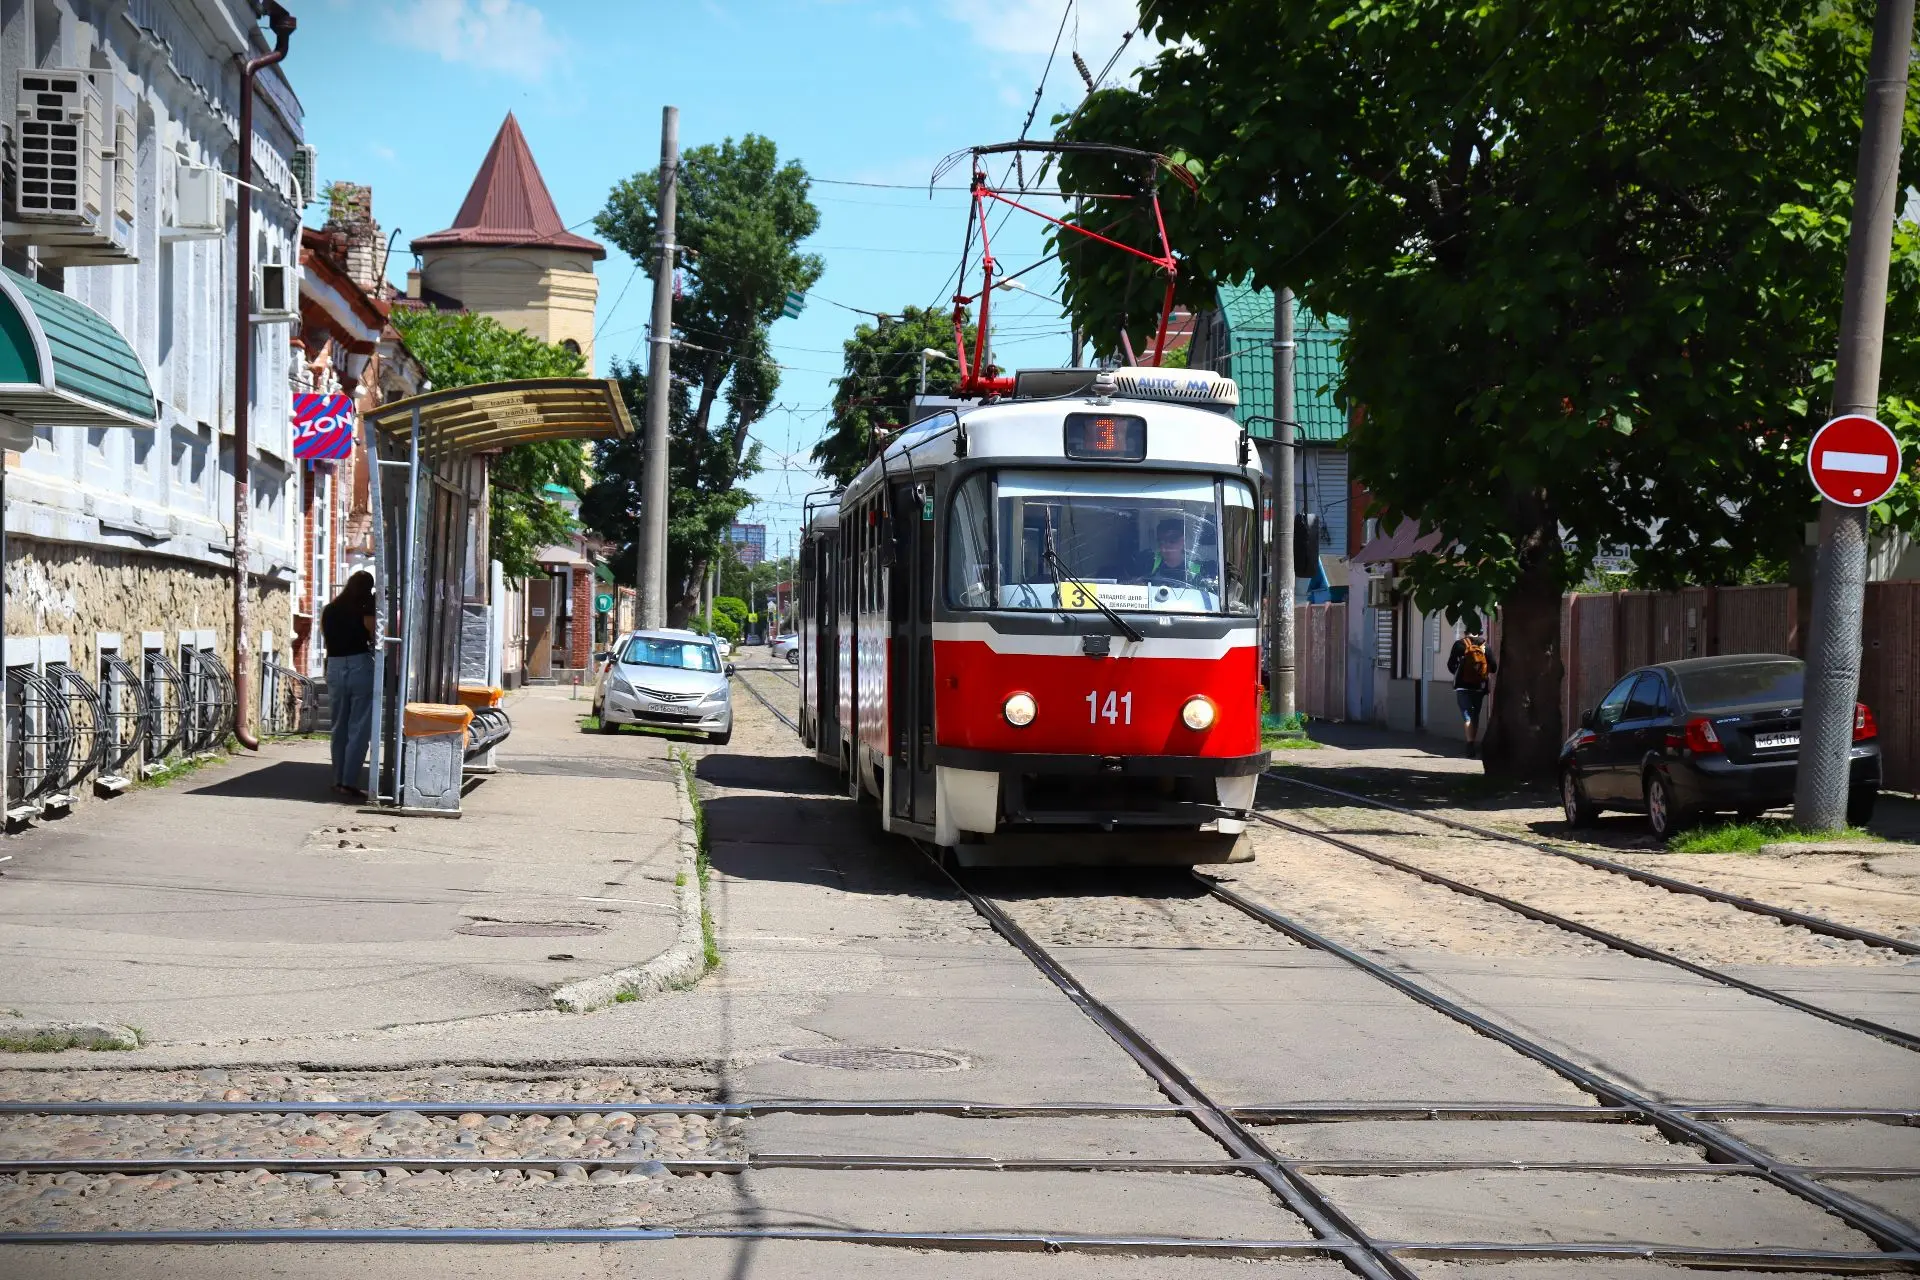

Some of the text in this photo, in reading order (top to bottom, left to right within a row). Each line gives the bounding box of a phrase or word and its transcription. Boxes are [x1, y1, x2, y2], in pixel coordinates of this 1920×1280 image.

[1137, 377, 1209, 391] AUTOCMA
[1096, 419, 1114, 449] 3
[1072, 589, 1085, 607] 3
[1086, 690, 1131, 724] 141
